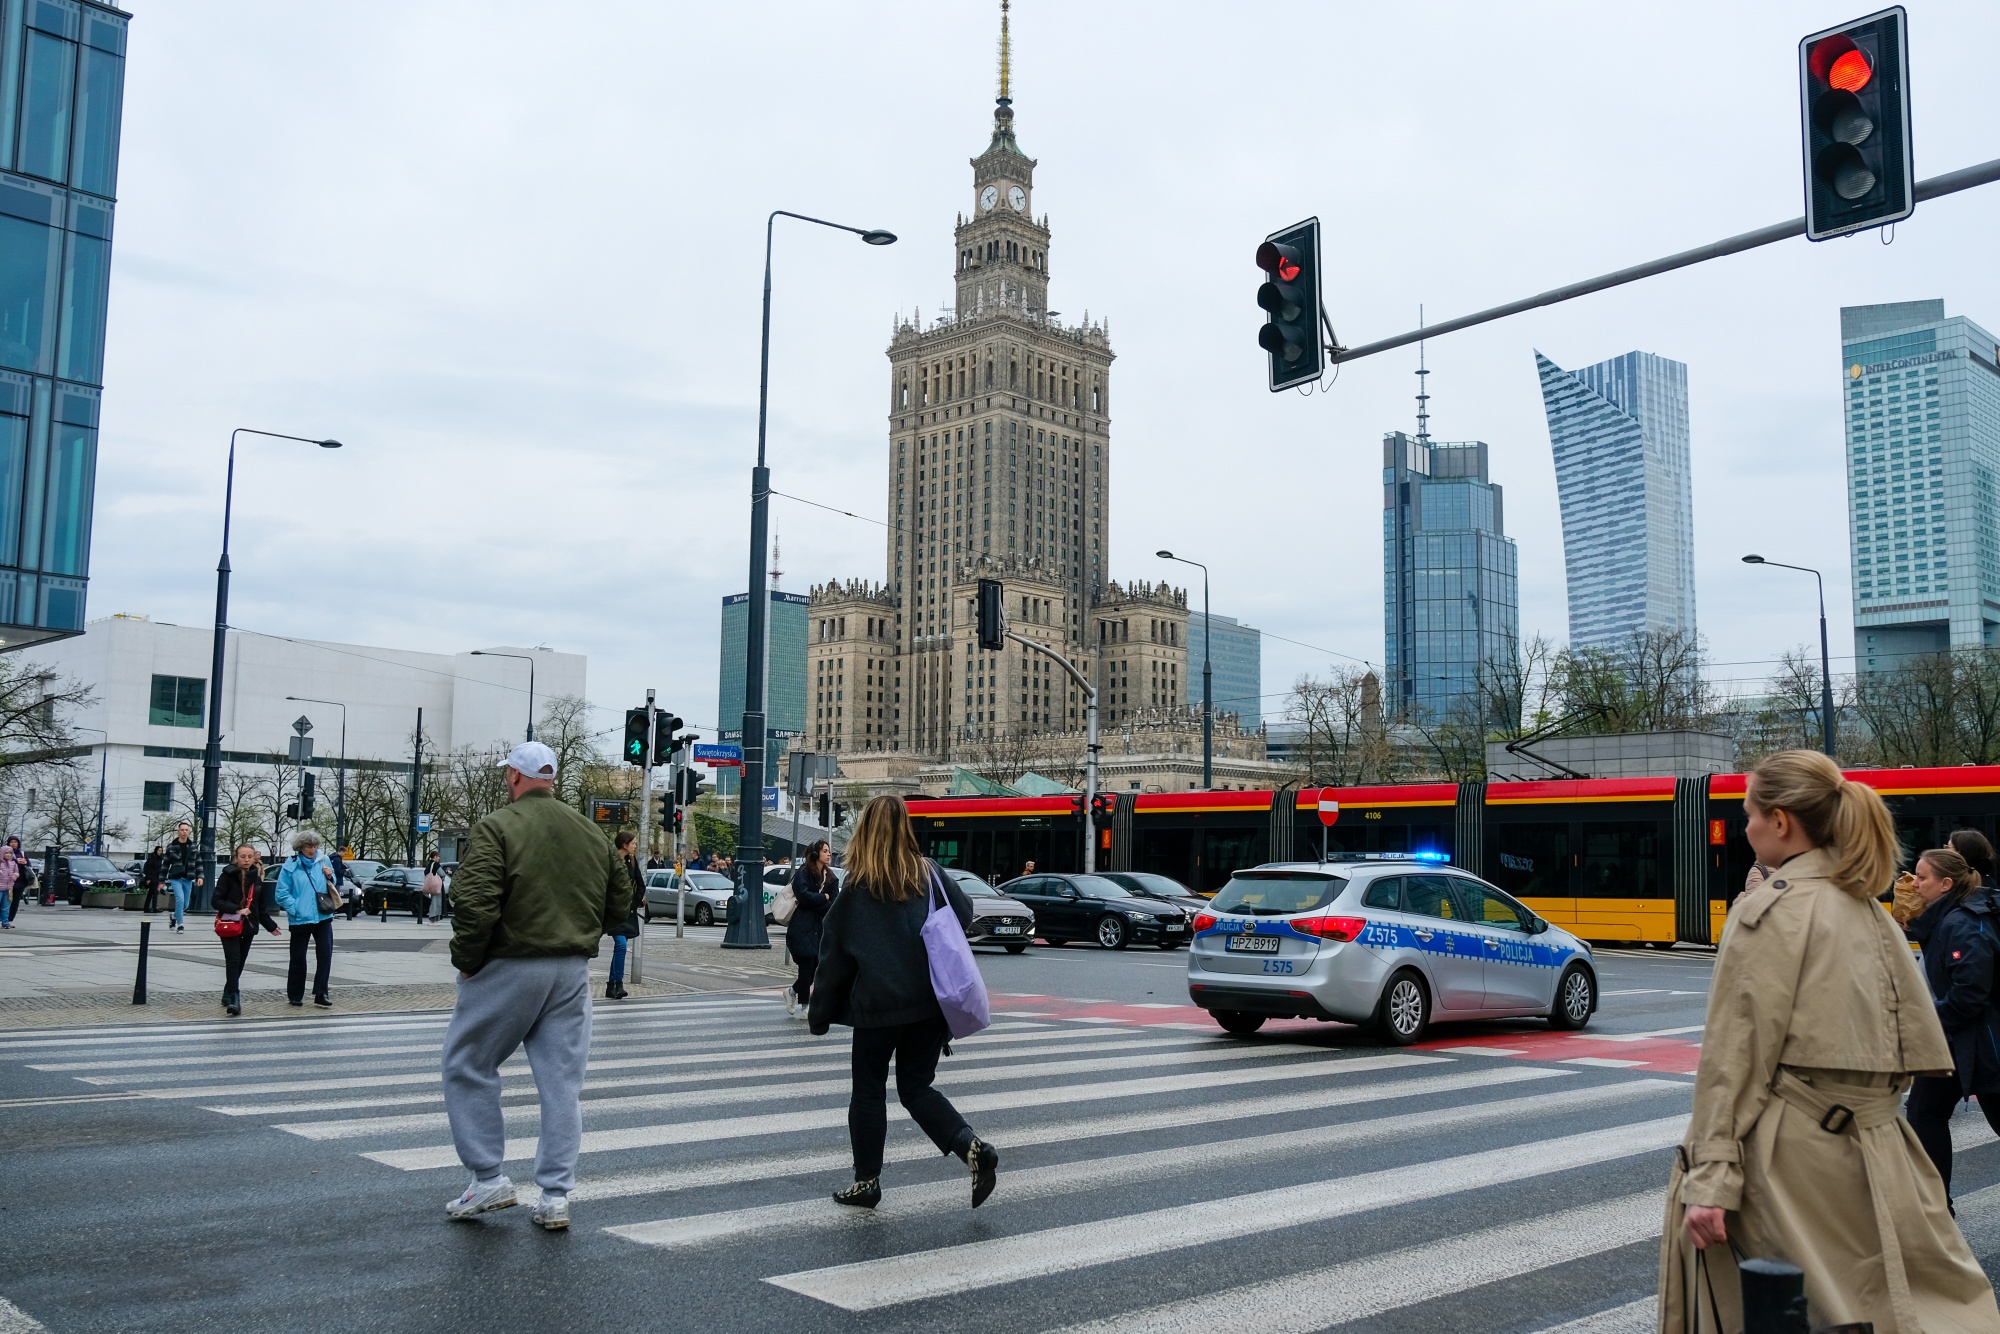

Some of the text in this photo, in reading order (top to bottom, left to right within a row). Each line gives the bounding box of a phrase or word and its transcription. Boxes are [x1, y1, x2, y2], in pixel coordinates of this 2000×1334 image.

[697, 747, 737, 759] Świętokrzyska
[1364, 811, 1382, 820] 4106
[1216, 922, 1240, 931] POLICJA
[1231, 937, 1278, 950] HPZ B919
[1499, 943, 1534, 962] POLICJA
[1272, 960, 1293, 974] 575
